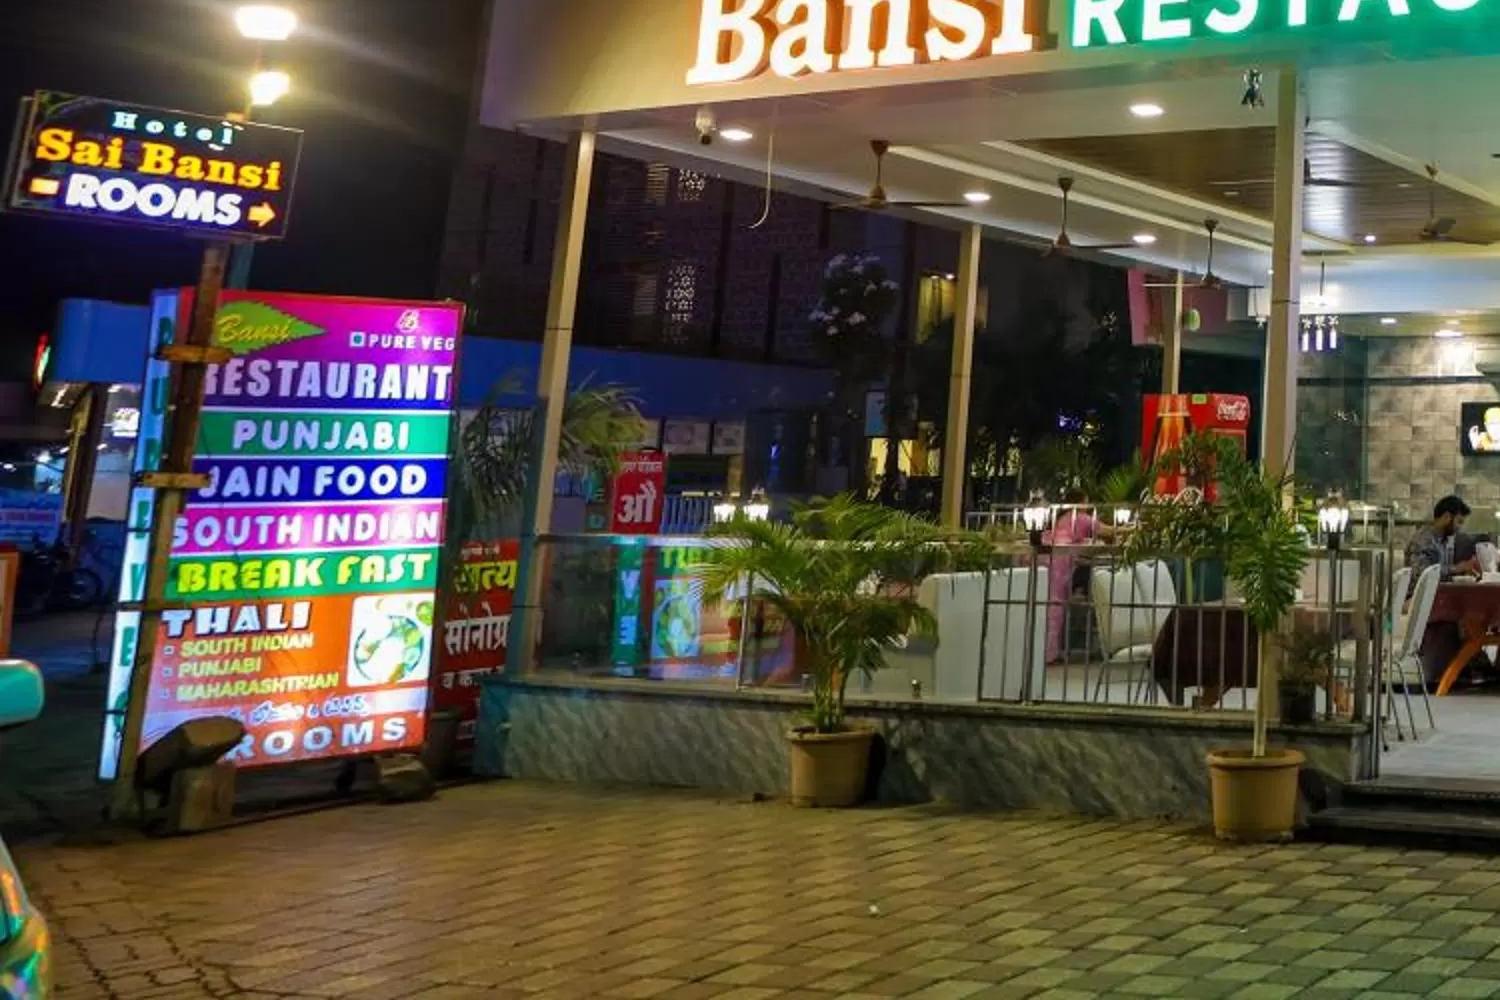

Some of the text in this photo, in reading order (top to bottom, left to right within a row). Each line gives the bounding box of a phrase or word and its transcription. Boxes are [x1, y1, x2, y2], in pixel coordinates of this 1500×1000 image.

[112, 111, 233, 145] Hotel
[36, 128, 282, 190] Sai Bansi
[64, 173, 242, 226] ROOMS
[216, 313, 292, 344] Bansi
[369, 333, 456, 351] PURE VEG
[232, 419, 410, 450] PUNJABI
[198, 464, 427, 498] JAIN FOOD
[171, 511, 438, 547] SOUTH INDIAN
[177, 557, 326, 593] BREAK
[336, 552, 433, 585] FAST
[160, 601, 313, 638] THALI
[179, 633, 313, 658] SOUTH INDIAN
[178, 658, 262, 678] PUNJABI
[177, 673, 339, 700] MAHARASHTRIAN
